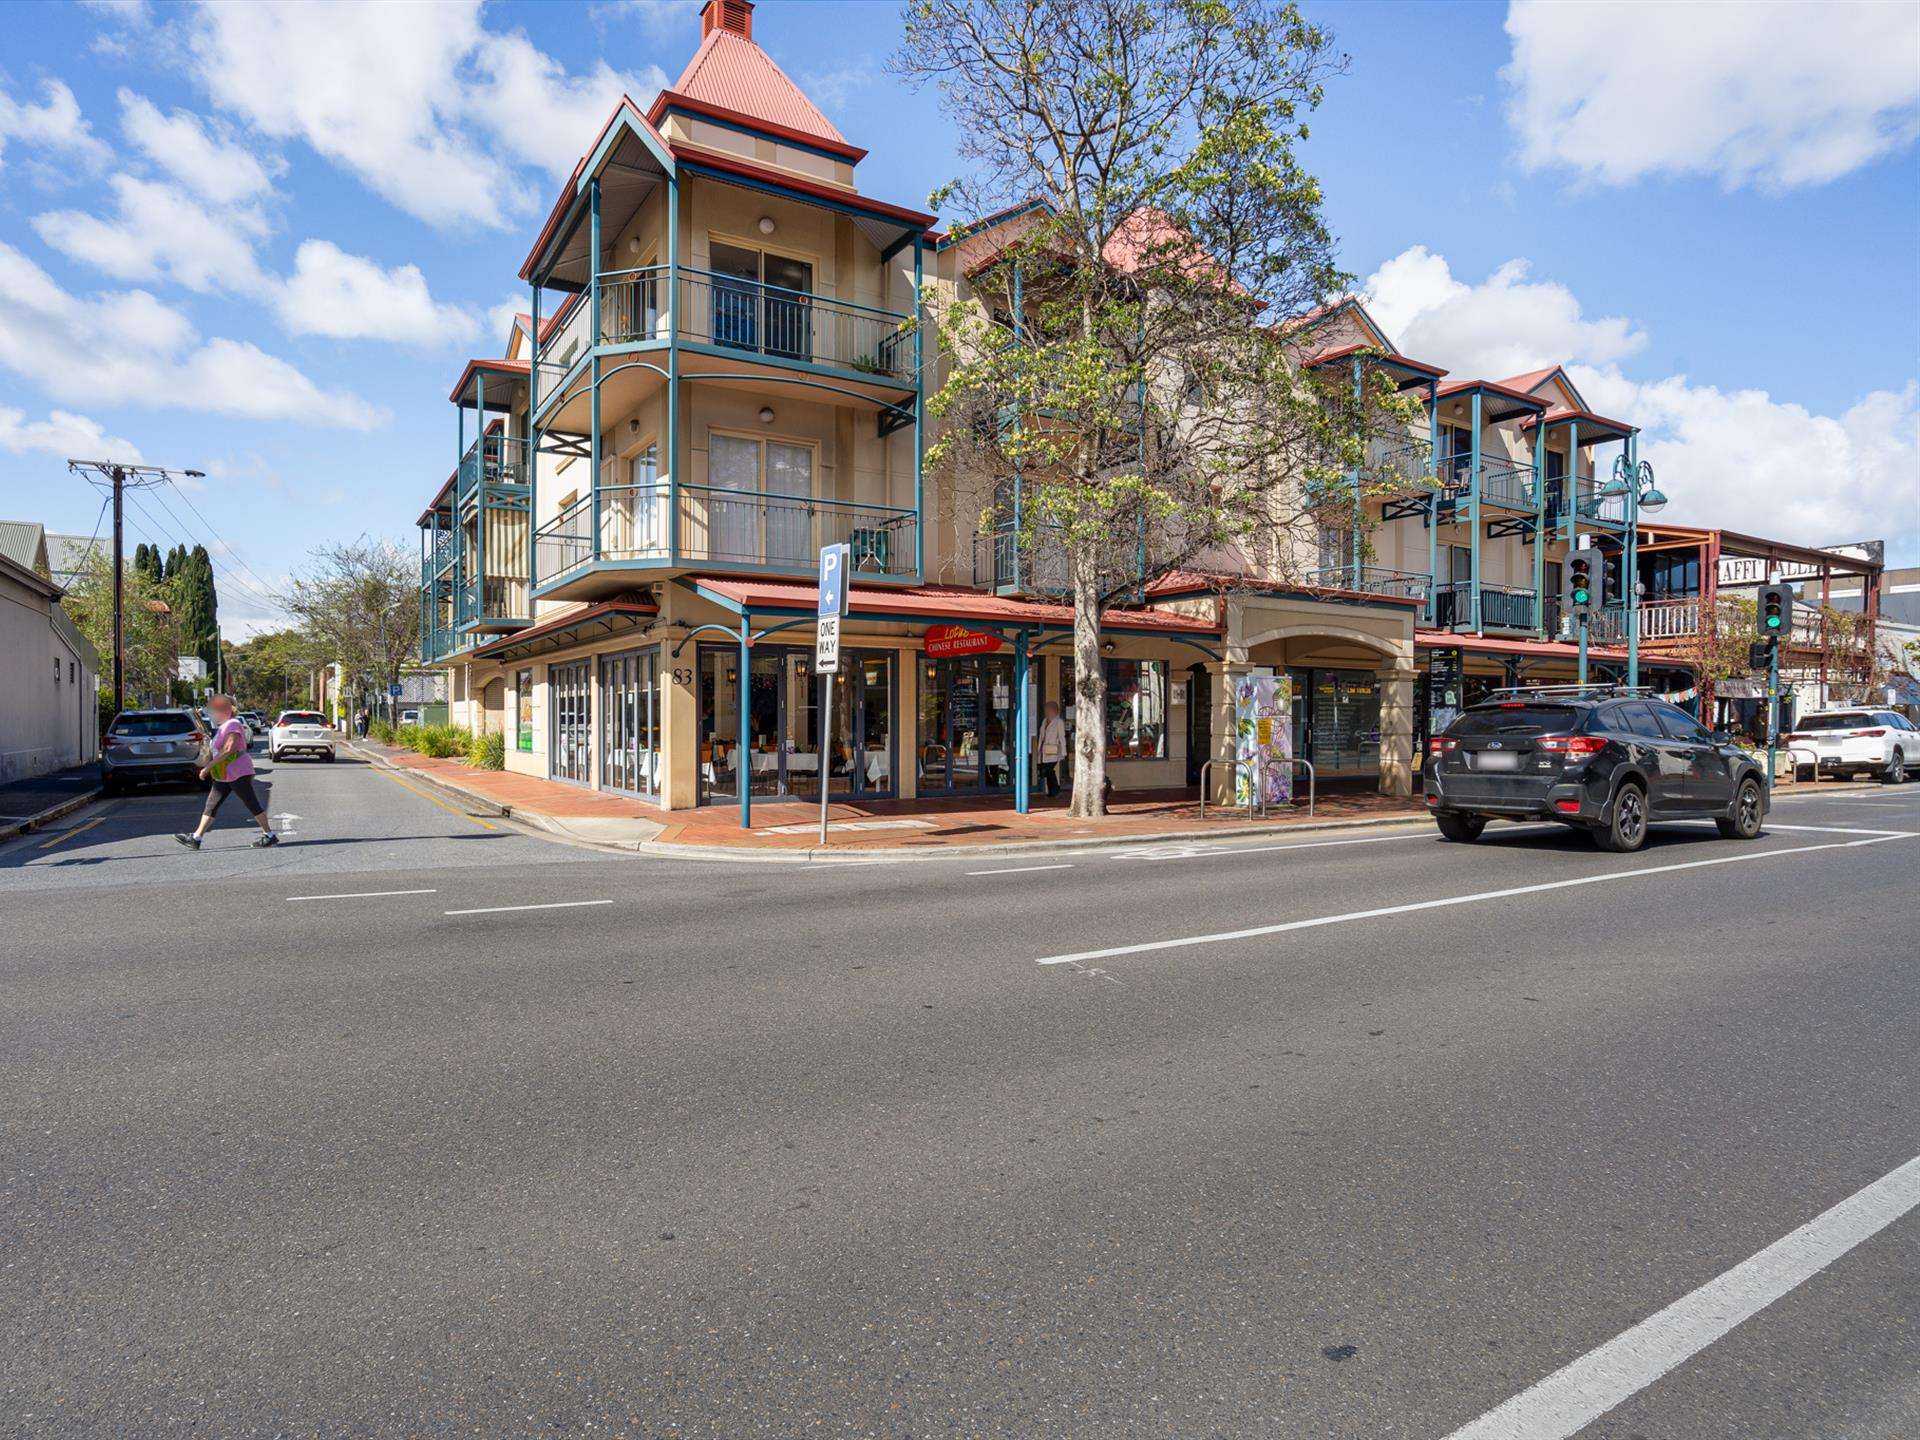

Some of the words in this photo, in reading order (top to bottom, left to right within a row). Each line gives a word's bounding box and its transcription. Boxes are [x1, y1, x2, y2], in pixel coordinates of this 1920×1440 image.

[824, 553, 837, 582] P
[820, 621, 836, 637] ONE
[819, 640, 837, 655] WAY
[928, 641, 951, 653] CHINESE
[953, 636, 988, 649] RESTAURANT
[672, 668, 692, 686] 83
